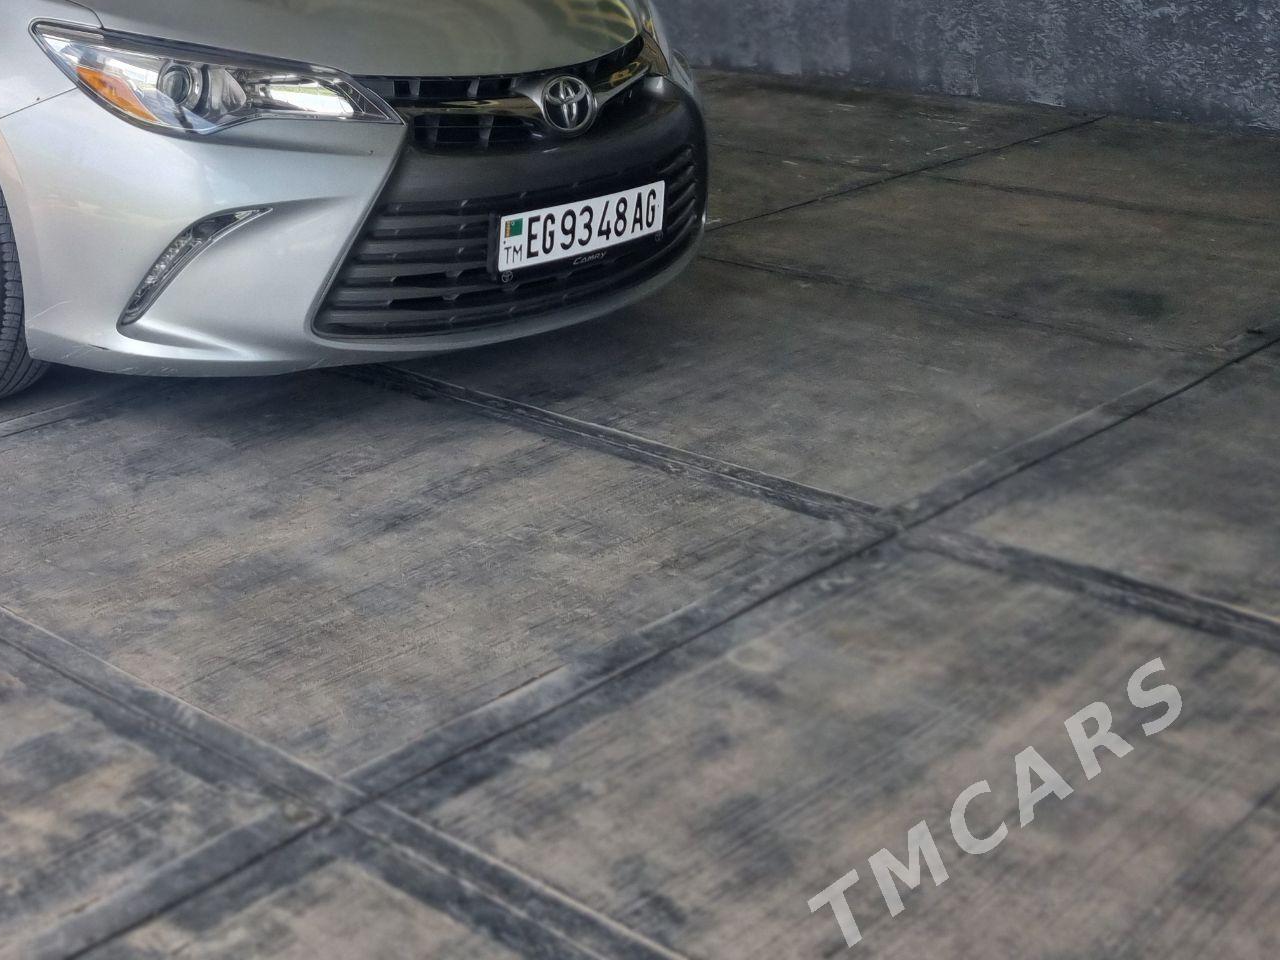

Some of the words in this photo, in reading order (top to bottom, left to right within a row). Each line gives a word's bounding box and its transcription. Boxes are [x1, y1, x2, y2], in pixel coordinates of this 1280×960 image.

[526, 188, 657, 259] EG9348AG
[504, 243, 523, 265] TM
[573, 250, 607, 265] CAMRY
